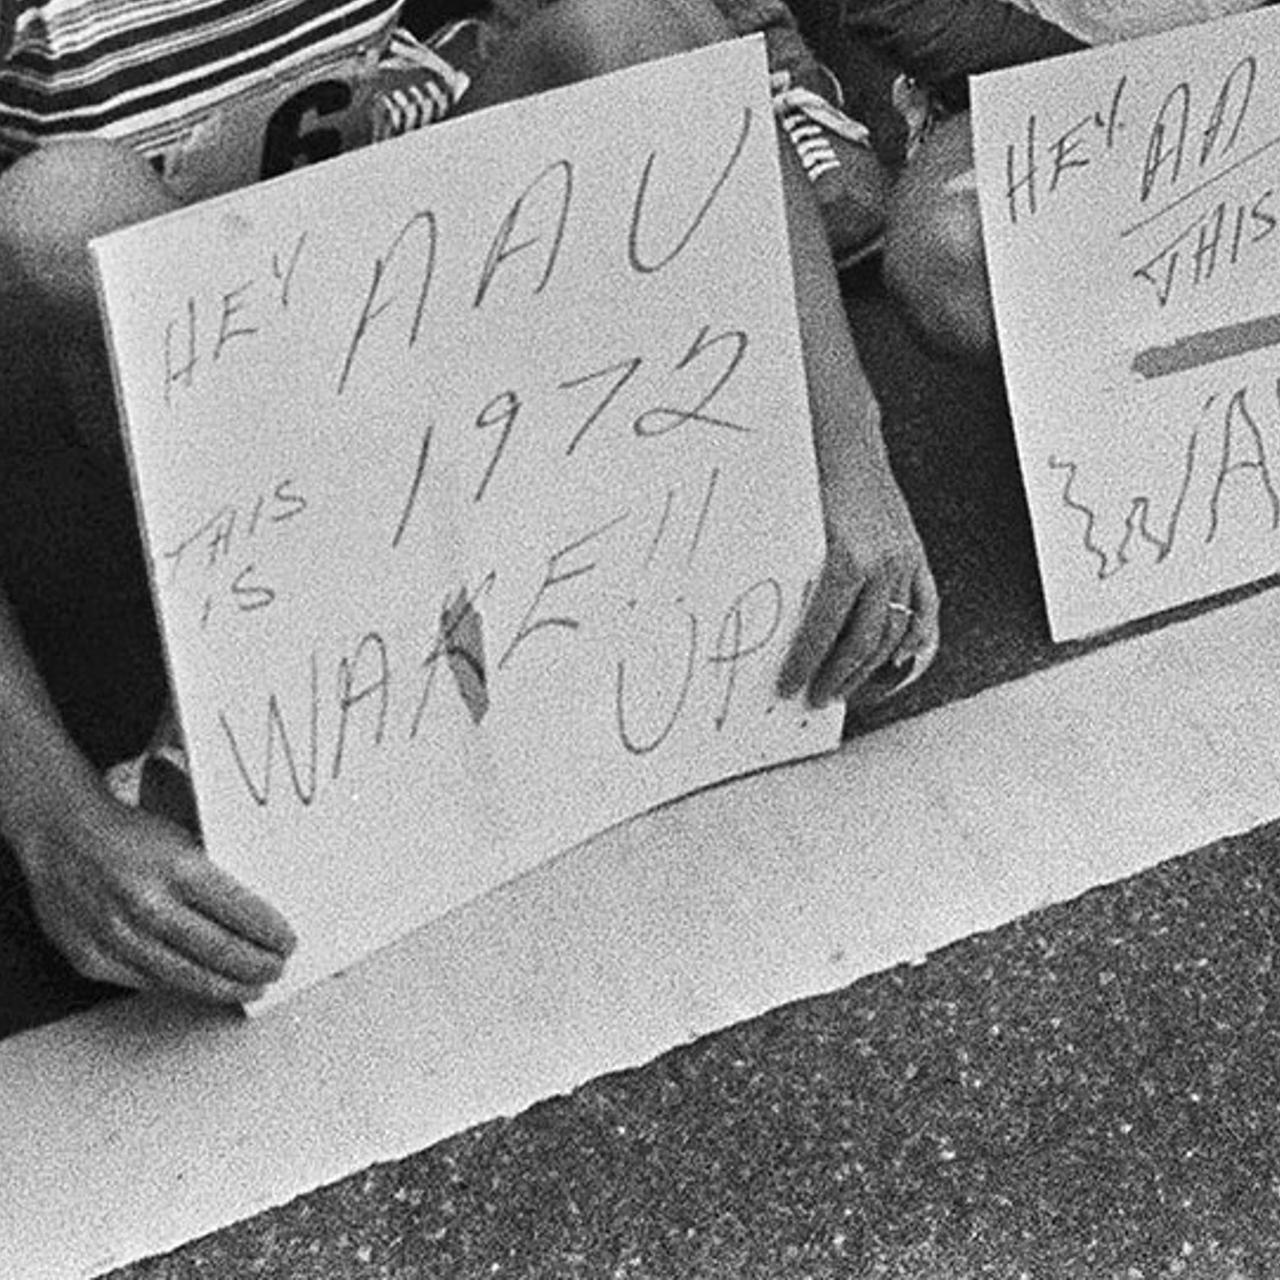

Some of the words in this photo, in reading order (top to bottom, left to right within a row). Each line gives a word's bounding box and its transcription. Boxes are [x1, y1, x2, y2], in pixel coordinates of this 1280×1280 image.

[1004, 76, 1126, 224] HEY
[164, 232, 309, 404] HEY
[338, 108, 753, 395] AAU
[1132, 192, 1277, 307] THIS
[391, 326, 752, 550] 1972
[164, 480, 307, 572] THIS
[202, 567, 275, 620] IS
